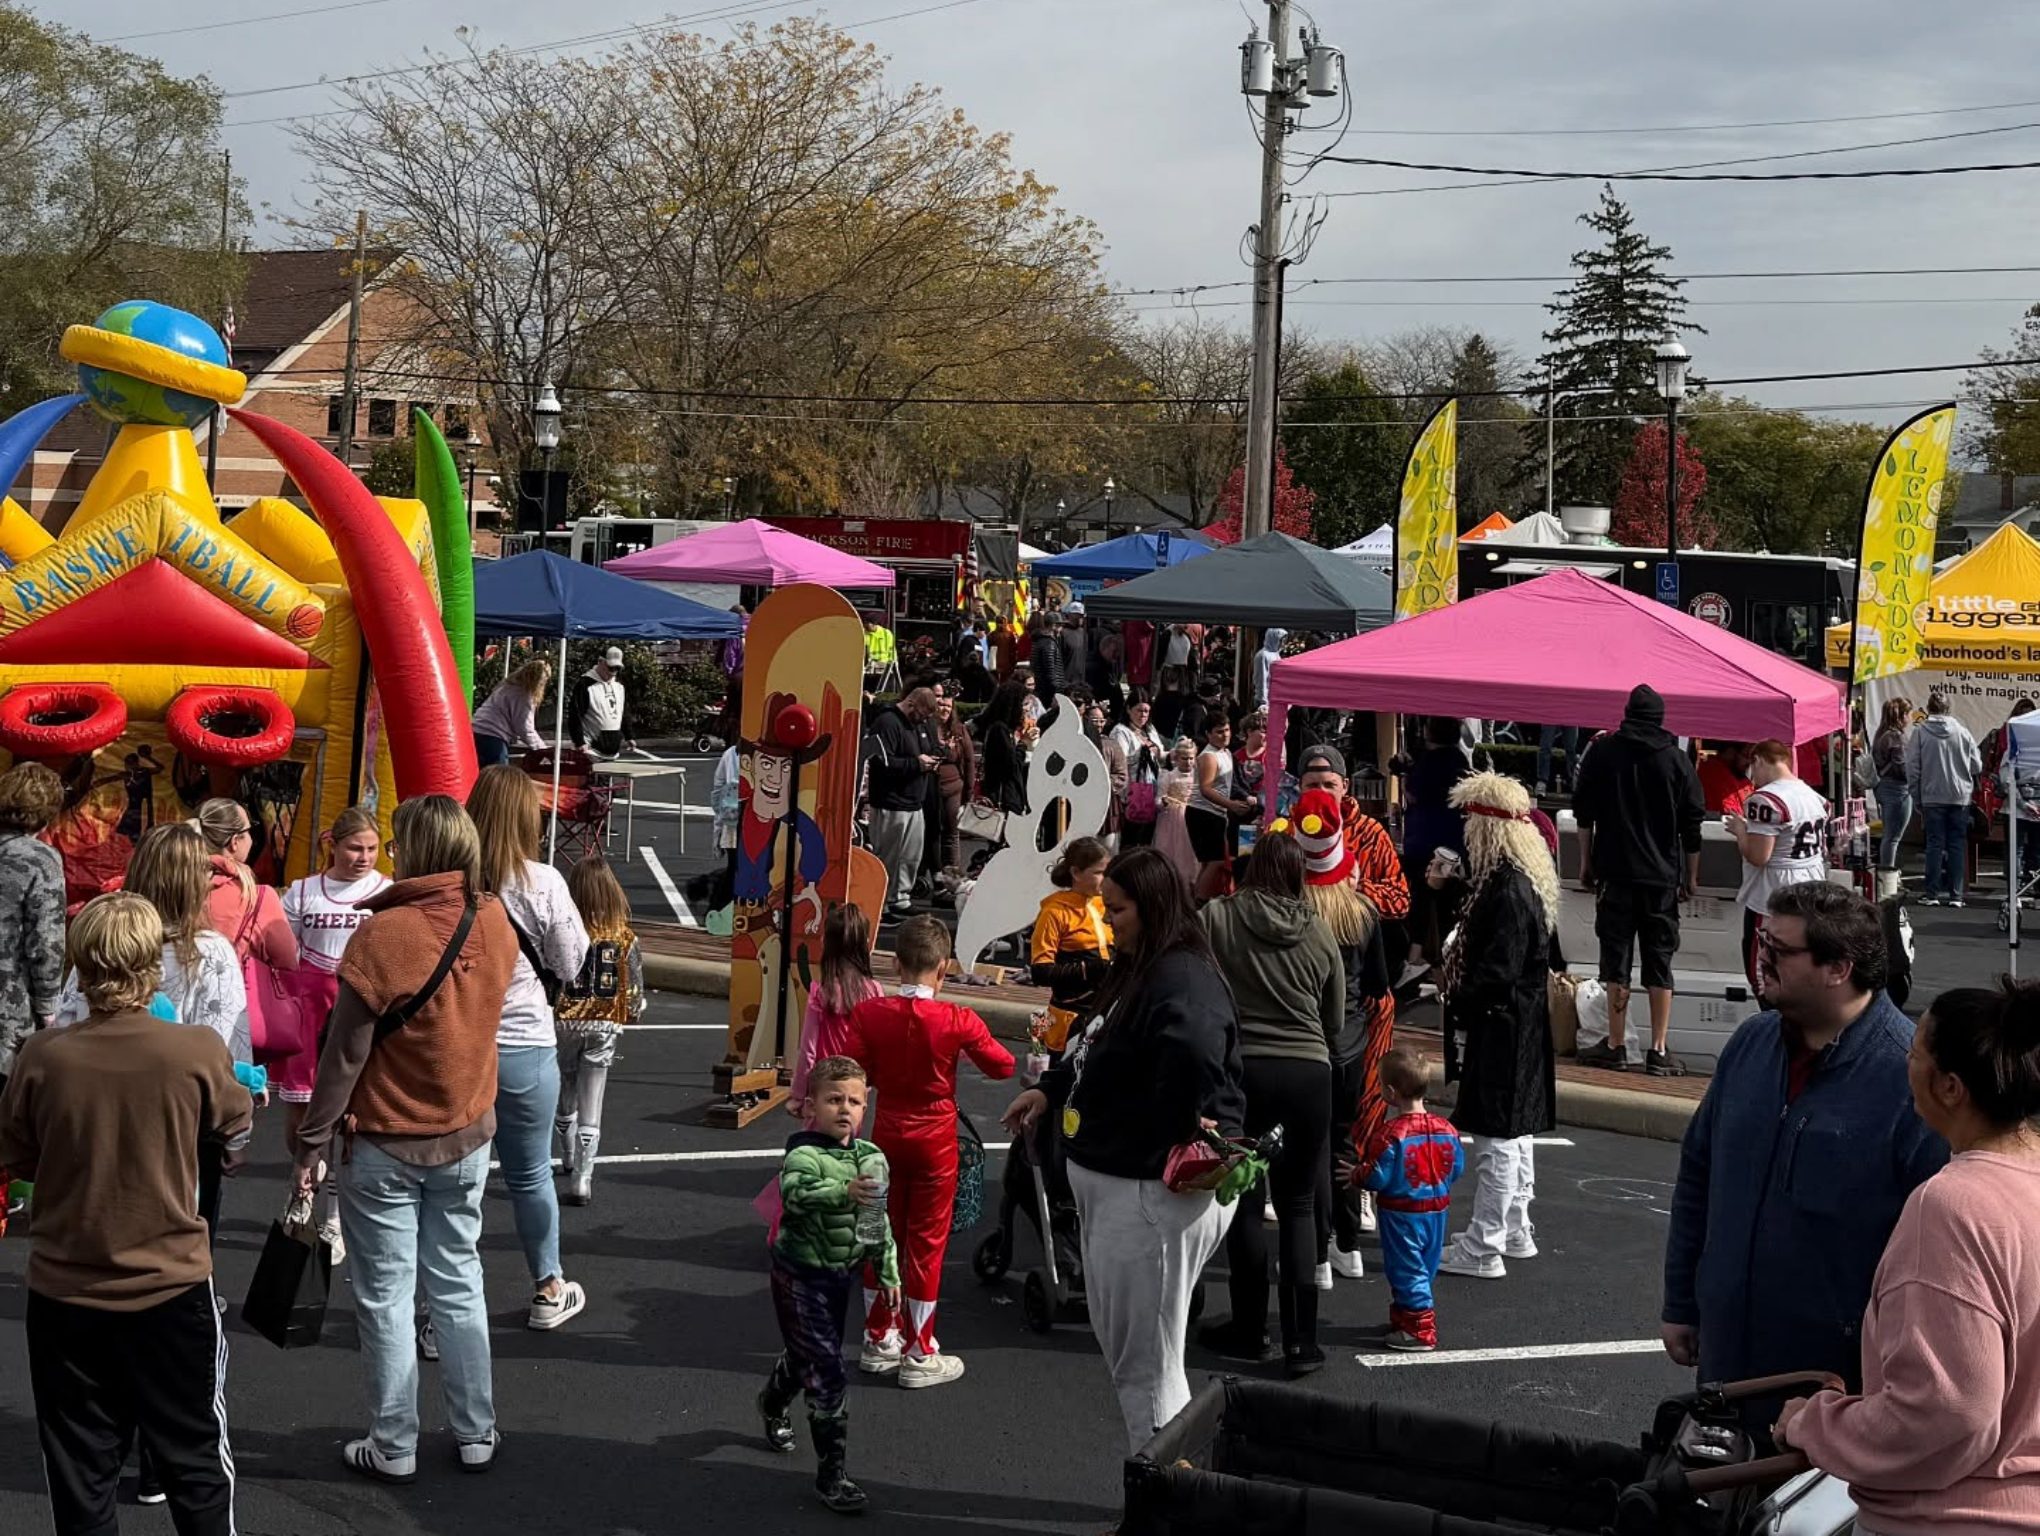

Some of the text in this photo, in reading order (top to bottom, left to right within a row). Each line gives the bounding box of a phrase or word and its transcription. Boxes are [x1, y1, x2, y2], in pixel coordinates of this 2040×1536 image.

[1417, 446, 1442, 610] LEMONAD
[876, 536, 912, 550] FIRE
[1888, 448, 1927, 654] LEMONADE
[1937, 595, 2016, 612] little
[1929, 682, 1957, 695] with
[1961, 683, 1982, 696] the
[1986, 686, 2027, 701] magic
[1747, 801, 1772, 822] 60
[302, 912, 369, 930] CHEE
